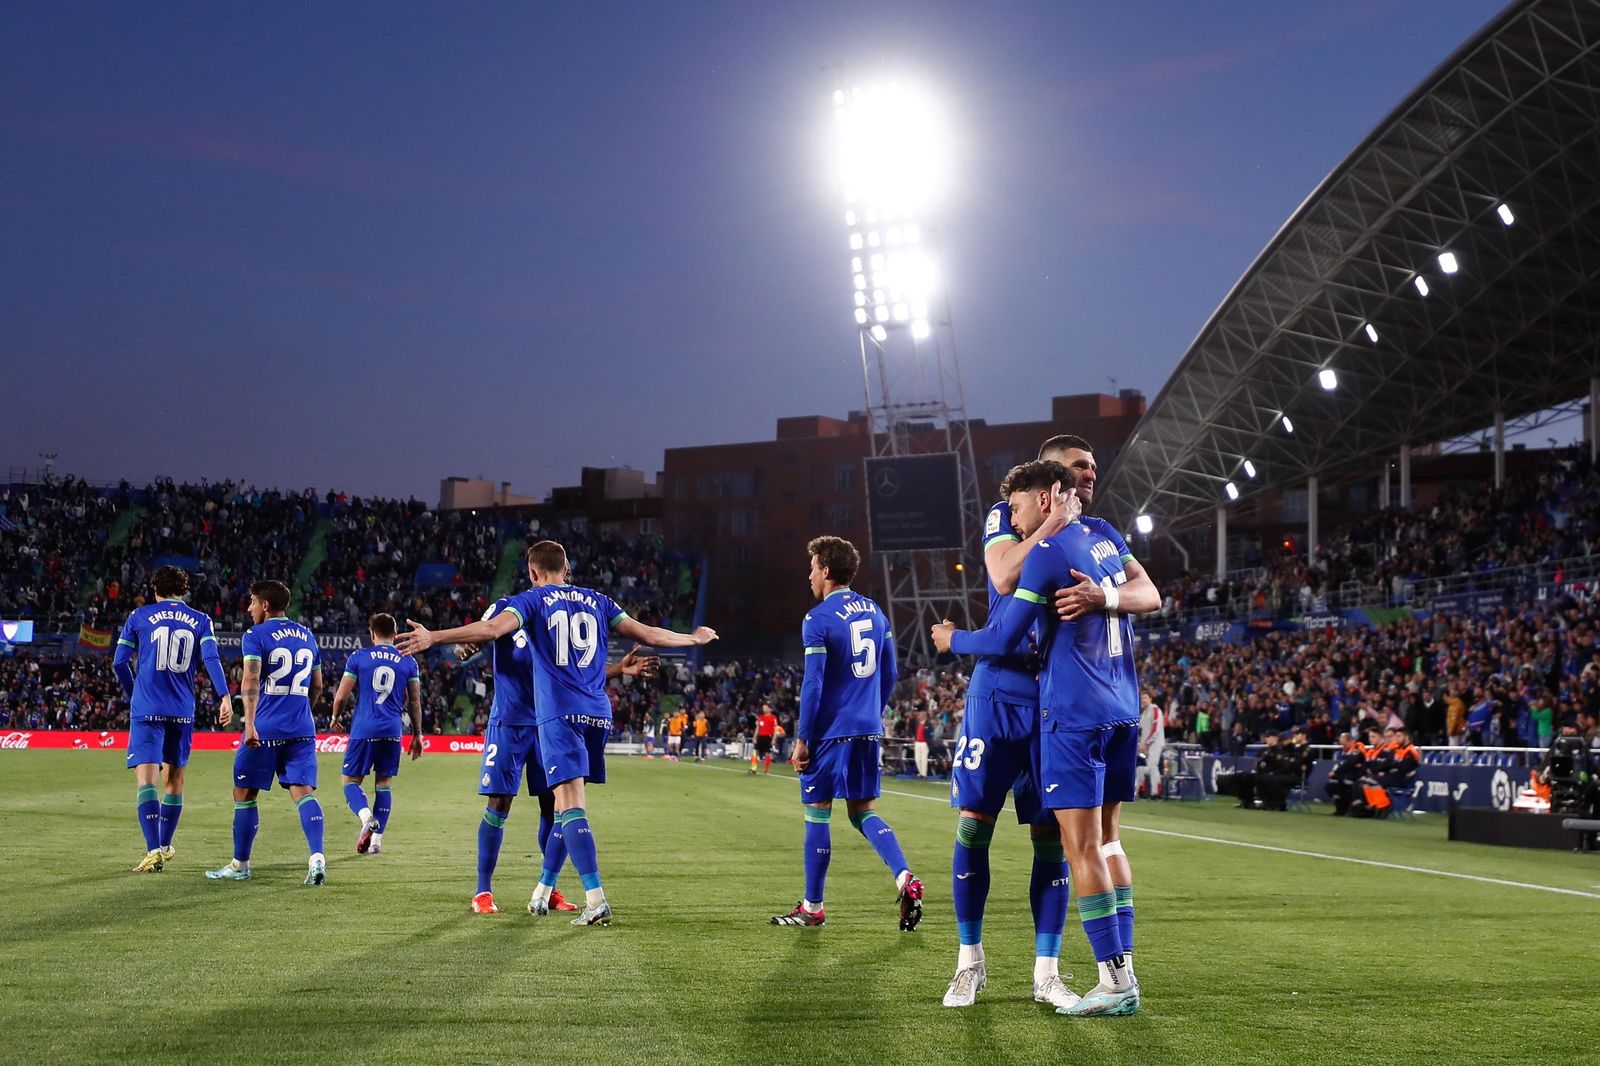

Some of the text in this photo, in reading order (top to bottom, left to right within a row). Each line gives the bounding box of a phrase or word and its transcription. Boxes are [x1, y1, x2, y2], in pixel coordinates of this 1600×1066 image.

[148, 610, 174, 625] ENES
[150, 626, 195, 674] 10
[370, 651, 402, 664] PORTU
[547, 609, 598, 668] 19
[849, 619, 877, 679] 5
[264, 647, 314, 697] 22
[372, 665, 396, 705] 9
[485, 743, 498, 767] 2
[952, 735, 986, 771] 23
